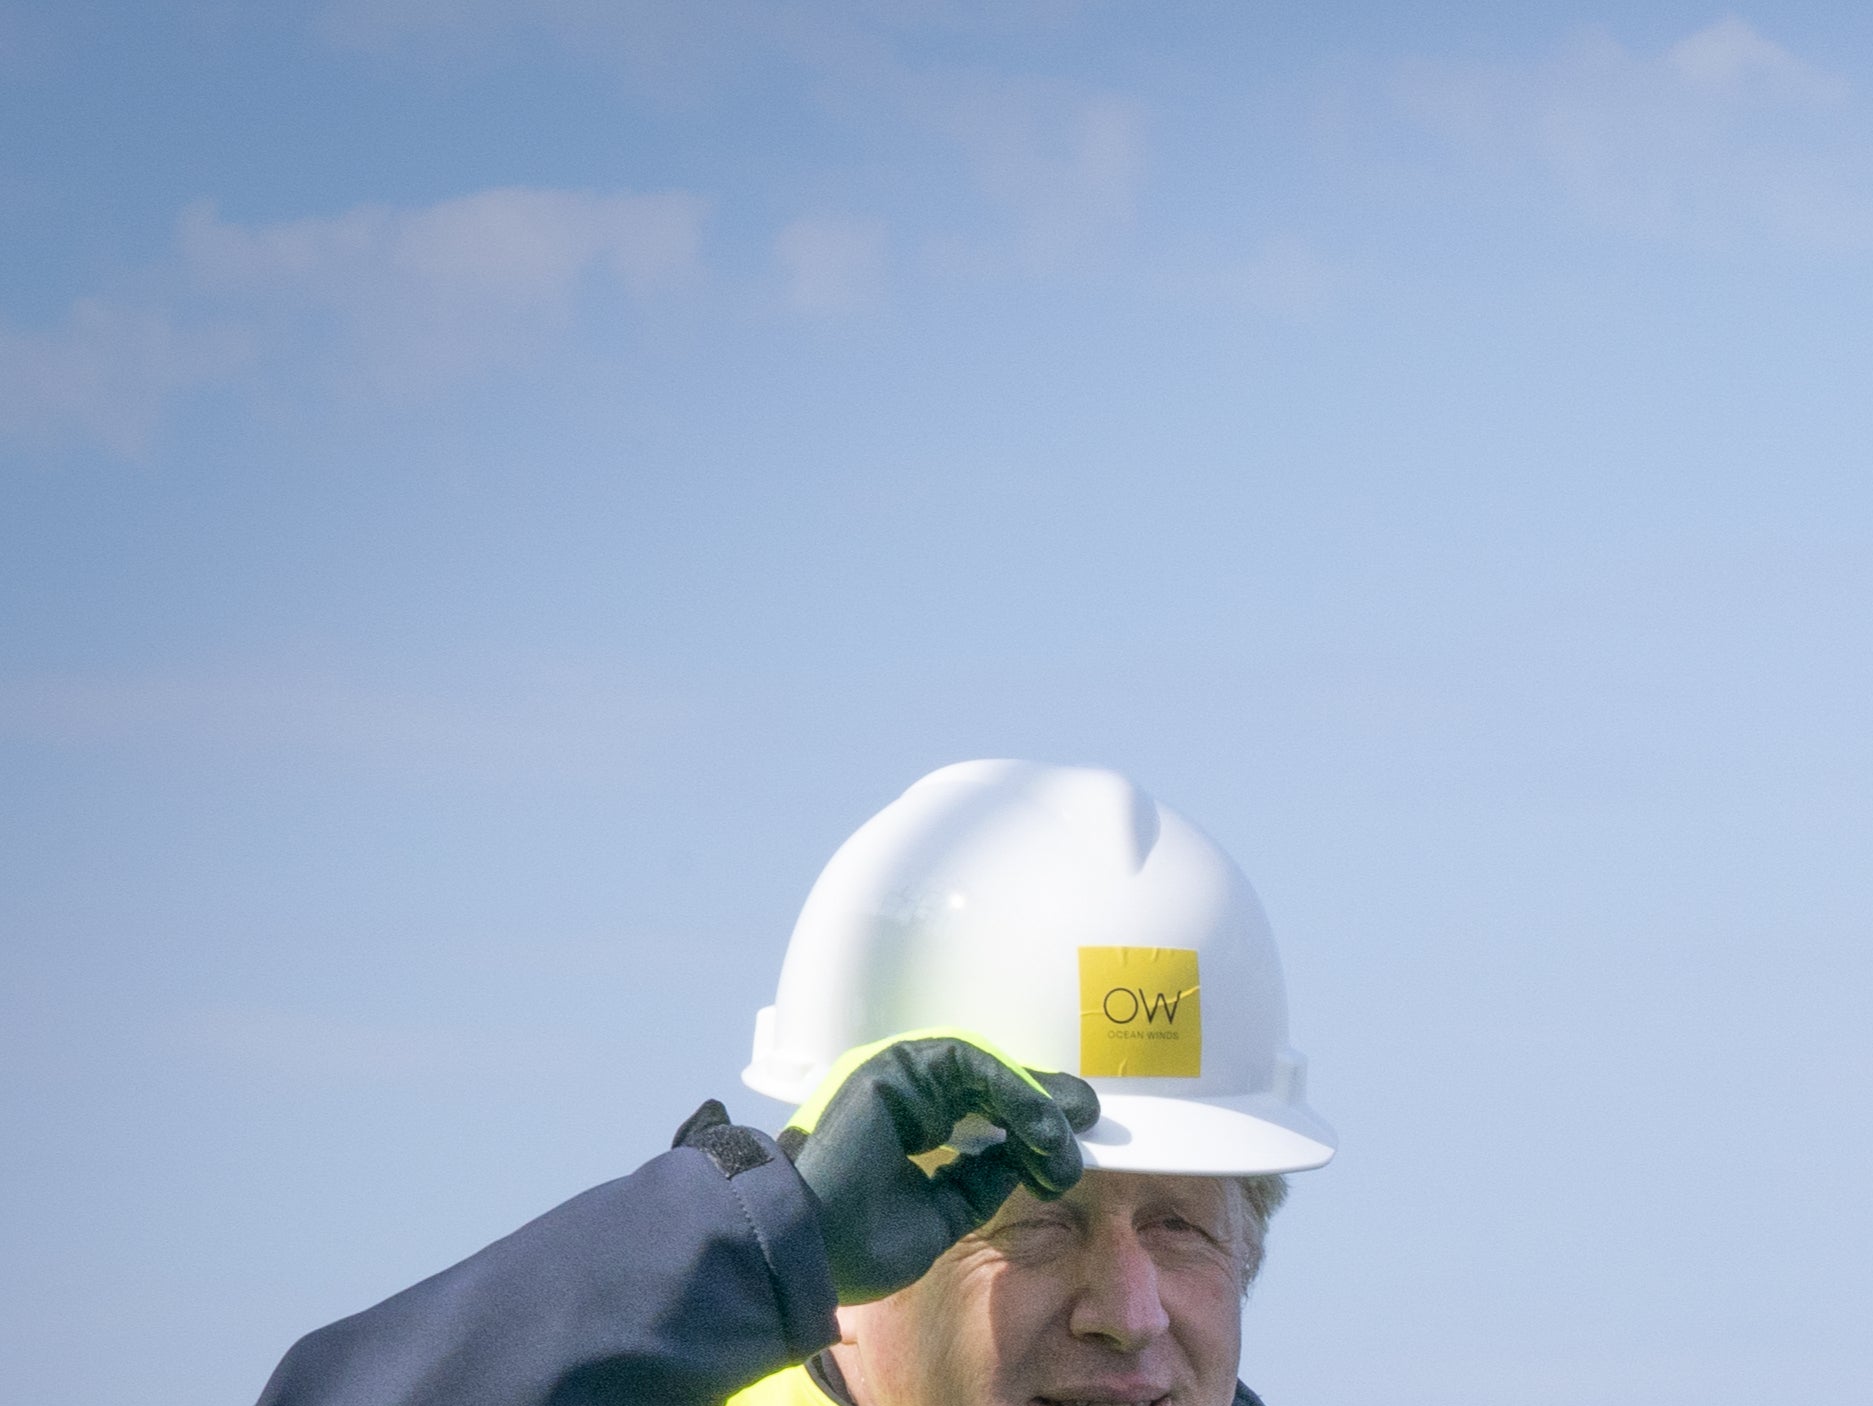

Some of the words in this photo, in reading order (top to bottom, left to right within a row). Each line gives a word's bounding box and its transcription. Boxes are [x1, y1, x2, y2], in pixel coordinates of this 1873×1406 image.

[1103, 987, 1182, 1024] OW
[1107, 1030, 1144, 1040] OCEAN
[1147, 1031, 1179, 1041] WINDS
